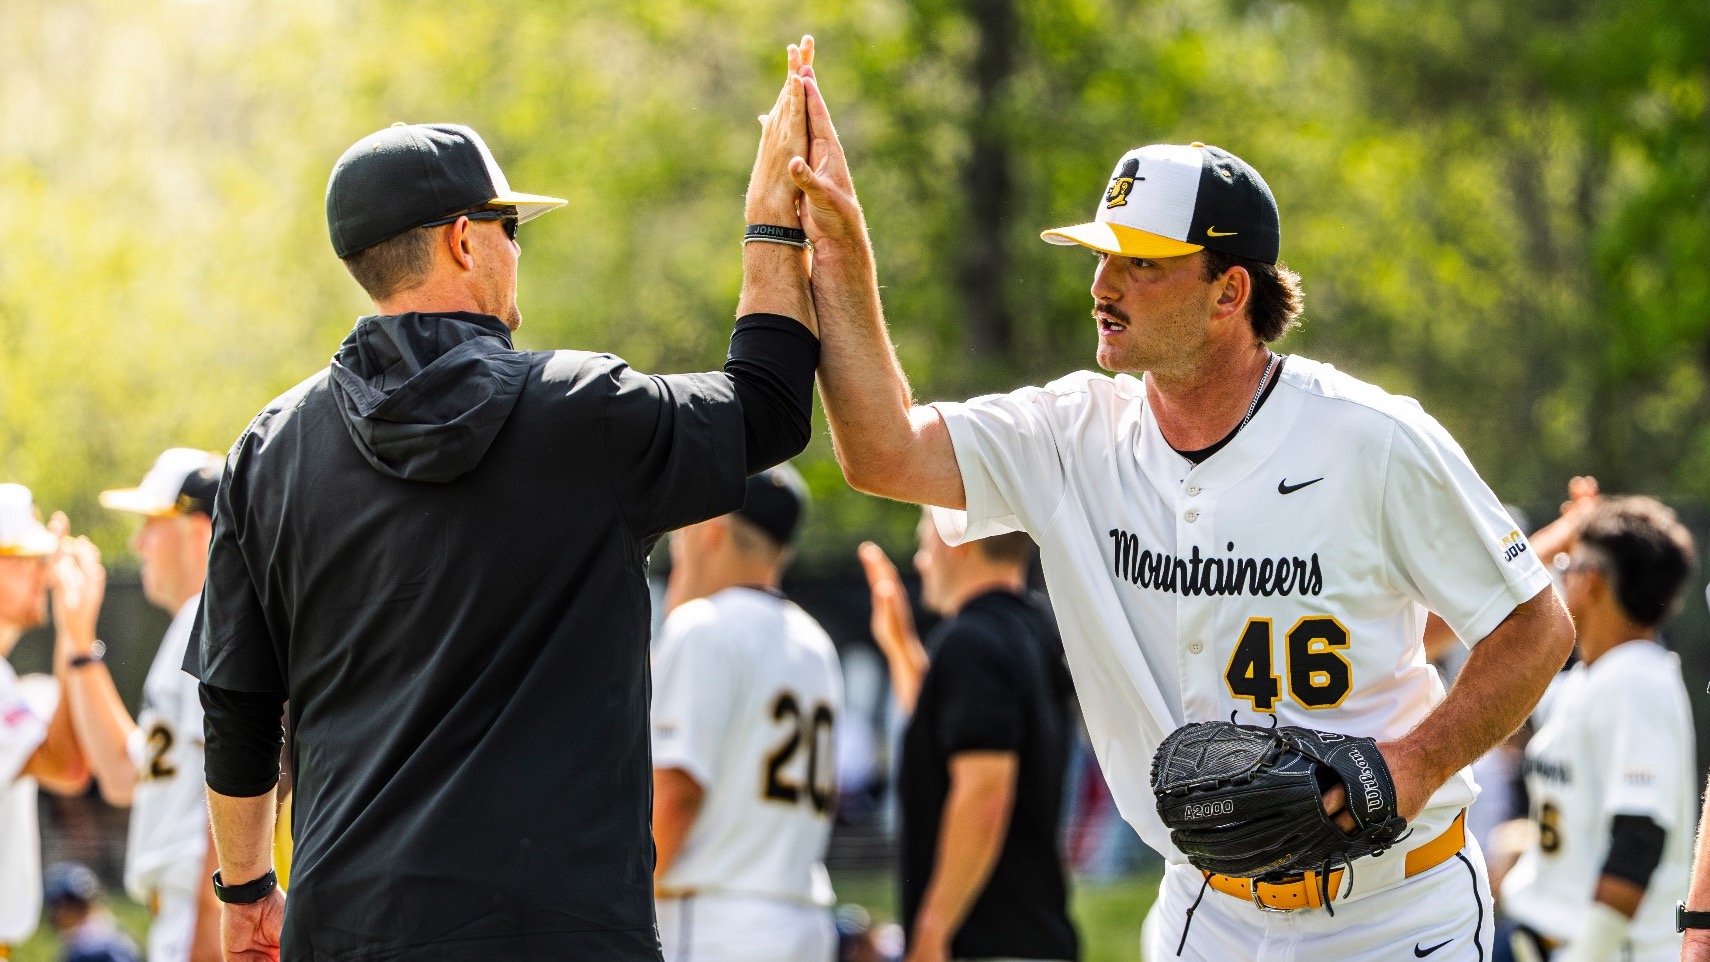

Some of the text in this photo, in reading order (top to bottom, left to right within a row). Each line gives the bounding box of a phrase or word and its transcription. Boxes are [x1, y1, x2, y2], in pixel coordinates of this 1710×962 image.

[754, 225, 784, 236] JOHN
[1109, 528, 1323, 597] Mountaineers
[1223, 614, 1353, 713] 46
[763, 689, 834, 816] 20
[1348, 748, 1384, 813] Wilson
[1184, 800, 1234, 820] A2000
